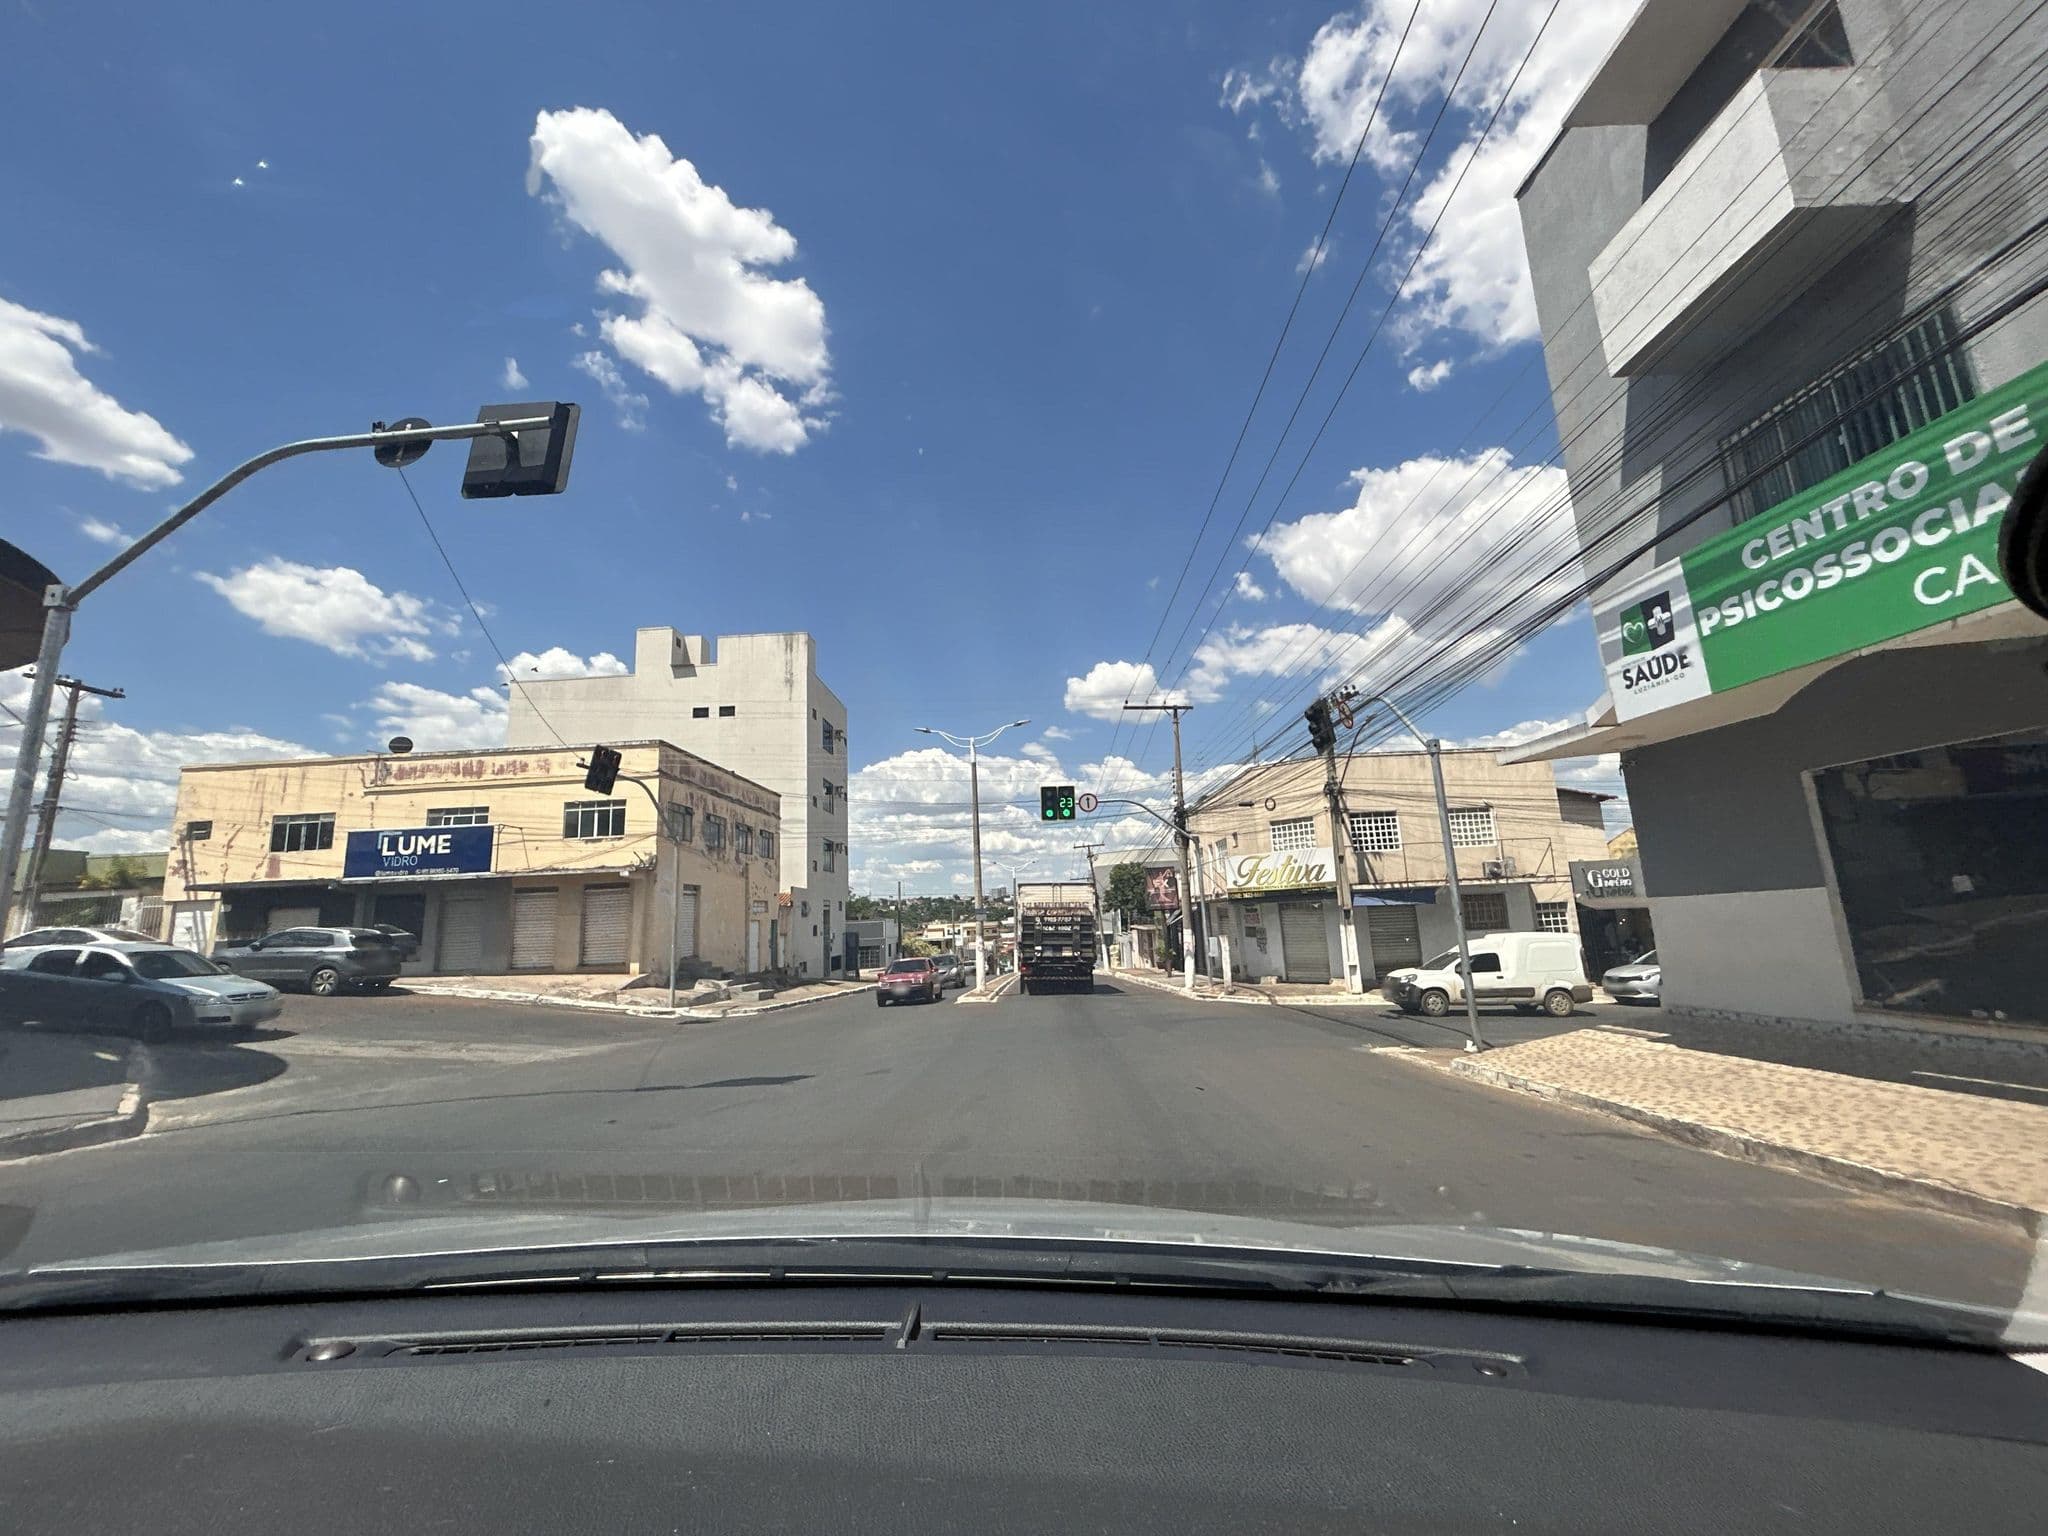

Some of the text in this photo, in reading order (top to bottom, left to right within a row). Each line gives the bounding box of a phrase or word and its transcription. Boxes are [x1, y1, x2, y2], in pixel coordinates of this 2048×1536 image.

[1742, 404, 2037, 570] CENTRO DE
[1697, 463, 2030, 637] PSICOSSOCIA
[1912, 552, 2002, 605] CA
[1623, 653, 1690, 690] SAÚDE
[1059, 797, 1074, 808] 23
[381, 834, 452, 856] LUME
[383, 855, 418, 867] VIDRO
[1233, 854, 1327, 888] Festiva
[1601, 868, 1630, 878] GOLD
